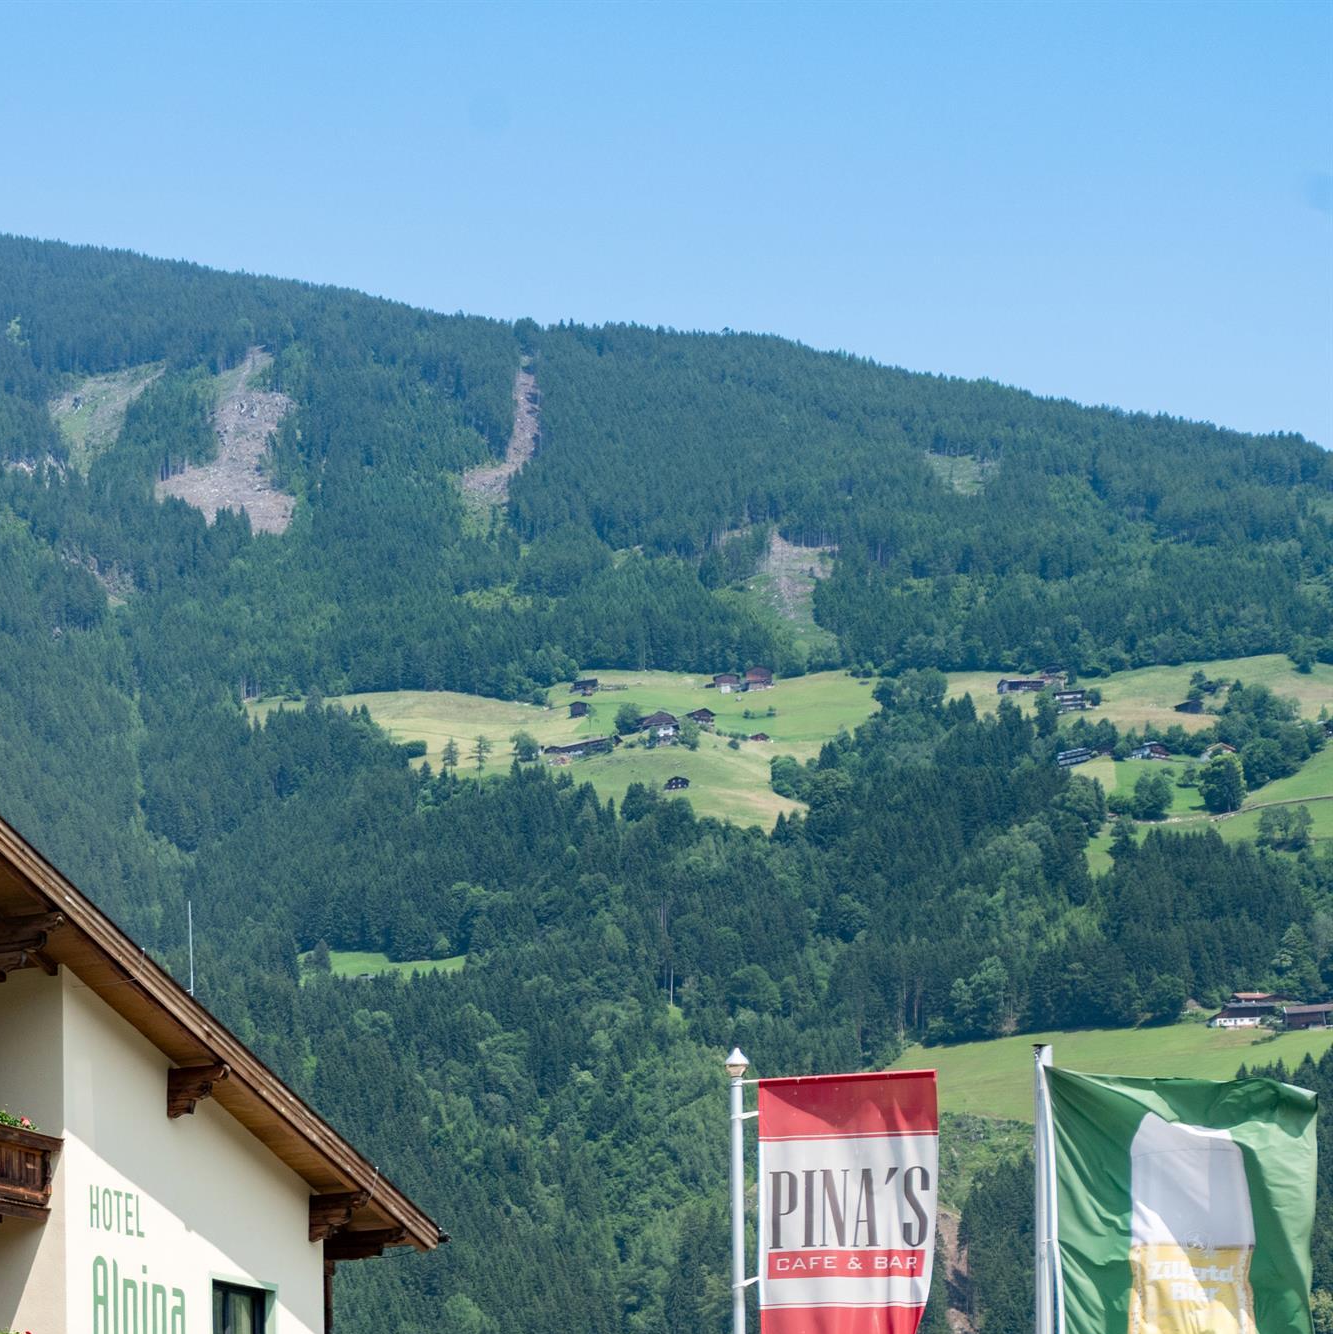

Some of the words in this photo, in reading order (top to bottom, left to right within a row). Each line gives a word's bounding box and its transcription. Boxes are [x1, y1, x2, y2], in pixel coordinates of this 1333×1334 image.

[89, 1184, 145, 1238] HOTEL
[776, 1256, 838, 1271] CAFE
[847, 1256, 862, 1270] &
[874, 1256, 918, 1270] BAR
